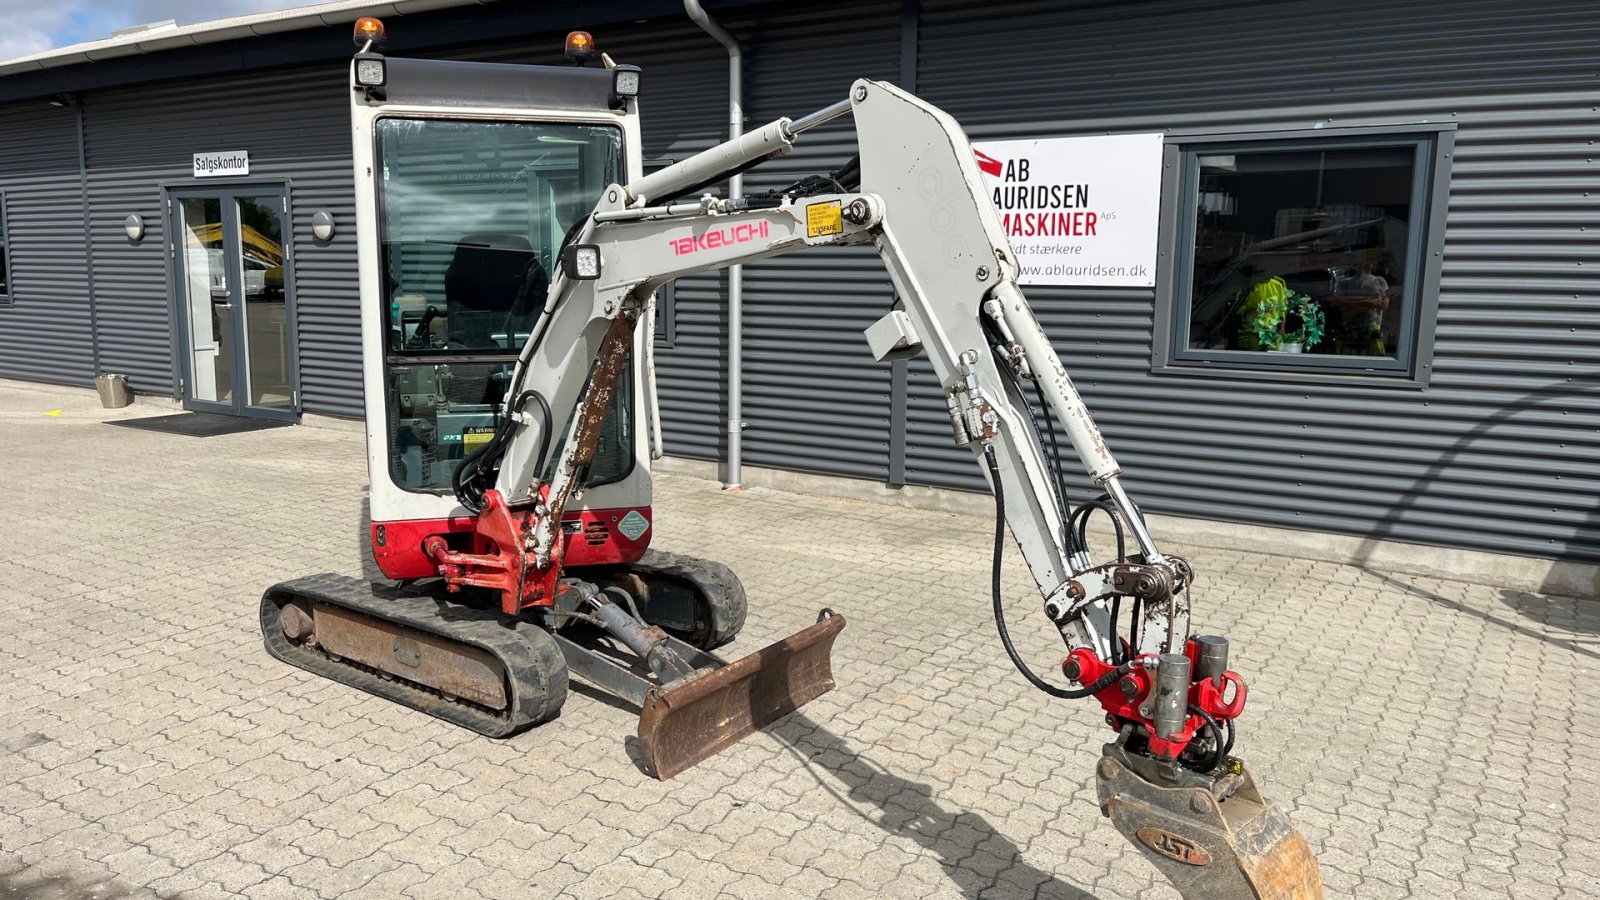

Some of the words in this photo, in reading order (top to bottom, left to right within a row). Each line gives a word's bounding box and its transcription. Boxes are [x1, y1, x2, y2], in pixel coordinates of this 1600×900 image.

[195, 155, 246, 173] Salgskontor
[1005, 159, 1030, 182] AB
[993, 184, 1089, 210] AURIDSEN
[1101, 212, 1116, 221] ApS
[1029, 243, 1082, 255] stærkere
